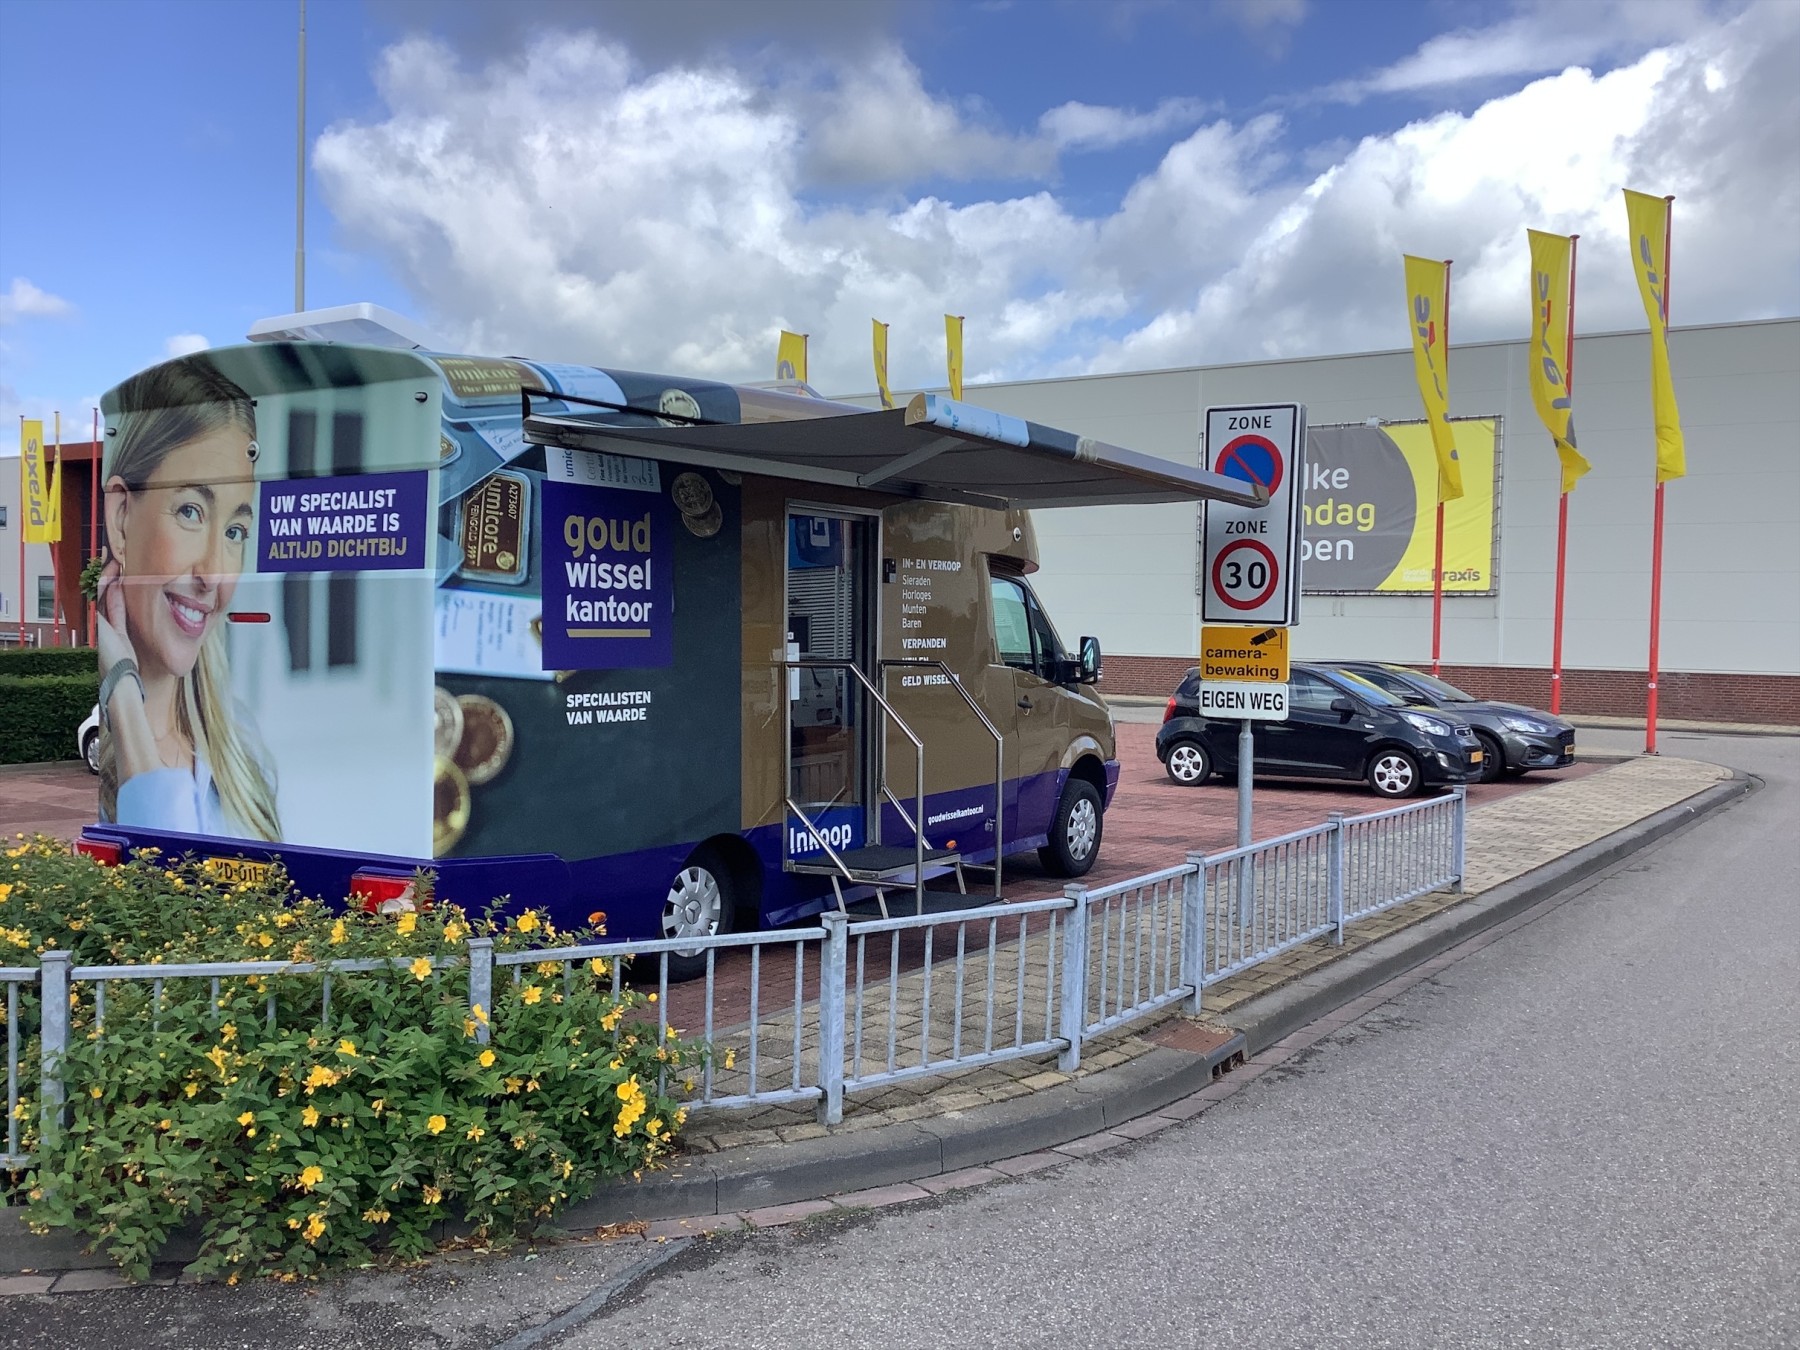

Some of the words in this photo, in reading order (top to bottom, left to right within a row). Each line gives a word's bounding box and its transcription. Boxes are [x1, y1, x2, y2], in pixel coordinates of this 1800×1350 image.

[1228, 415, 1272, 430] ZONE
[562, 446, 575, 477] umic
[24, 438, 45, 526] praxis
[1304, 462, 1350, 490] lke
[270, 495, 296, 514] UW
[300, 489, 396, 512] SPECIALIST
[270, 517, 302, 536] VAN
[307, 514, 377, 535] WAARDE
[382, 513, 400, 532] IS
[483, 479, 504, 554] umicore
[1303, 498, 1376, 532] ndag
[564, 512, 651, 558] goud
[1225, 520, 1268, 534] ZONE
[268, 540, 322, 560] ALTIJD
[328, 537, 407, 558] DICHTBIJ
[565, 553, 652, 591] wissel
[902, 558, 914, 569] IN-
[916, 559, 926, 570] EN
[927, 559, 962, 571] VERKOOP
[902, 574, 931, 586] Sieraden
[1225, 562, 1267, 589] 30
[902, 589, 932, 603] Horloges
[566, 593, 653, 622] kantoor
[902, 603, 927, 614] Munten
[902, 617, 922, 629] Baren
[902, 637, 947, 649] VERPANDEN
[1206, 648, 1268, 659] camera-
[902, 675, 922, 687] GELD
[923, 673, 960, 686] WISSELN
[1205, 663, 1279, 680] bewaking
[566, 691, 652, 708] SPECIALISTEN
[1202, 690, 1245, 709] EIGEN
[1249, 692, 1284, 711] WEG
[566, 711, 592, 725] VAN
[596, 708, 647, 723] WAARDE
[927, 804, 984, 826] goudwisselkantoor.nl
[790, 823, 852, 854] Inkoop
